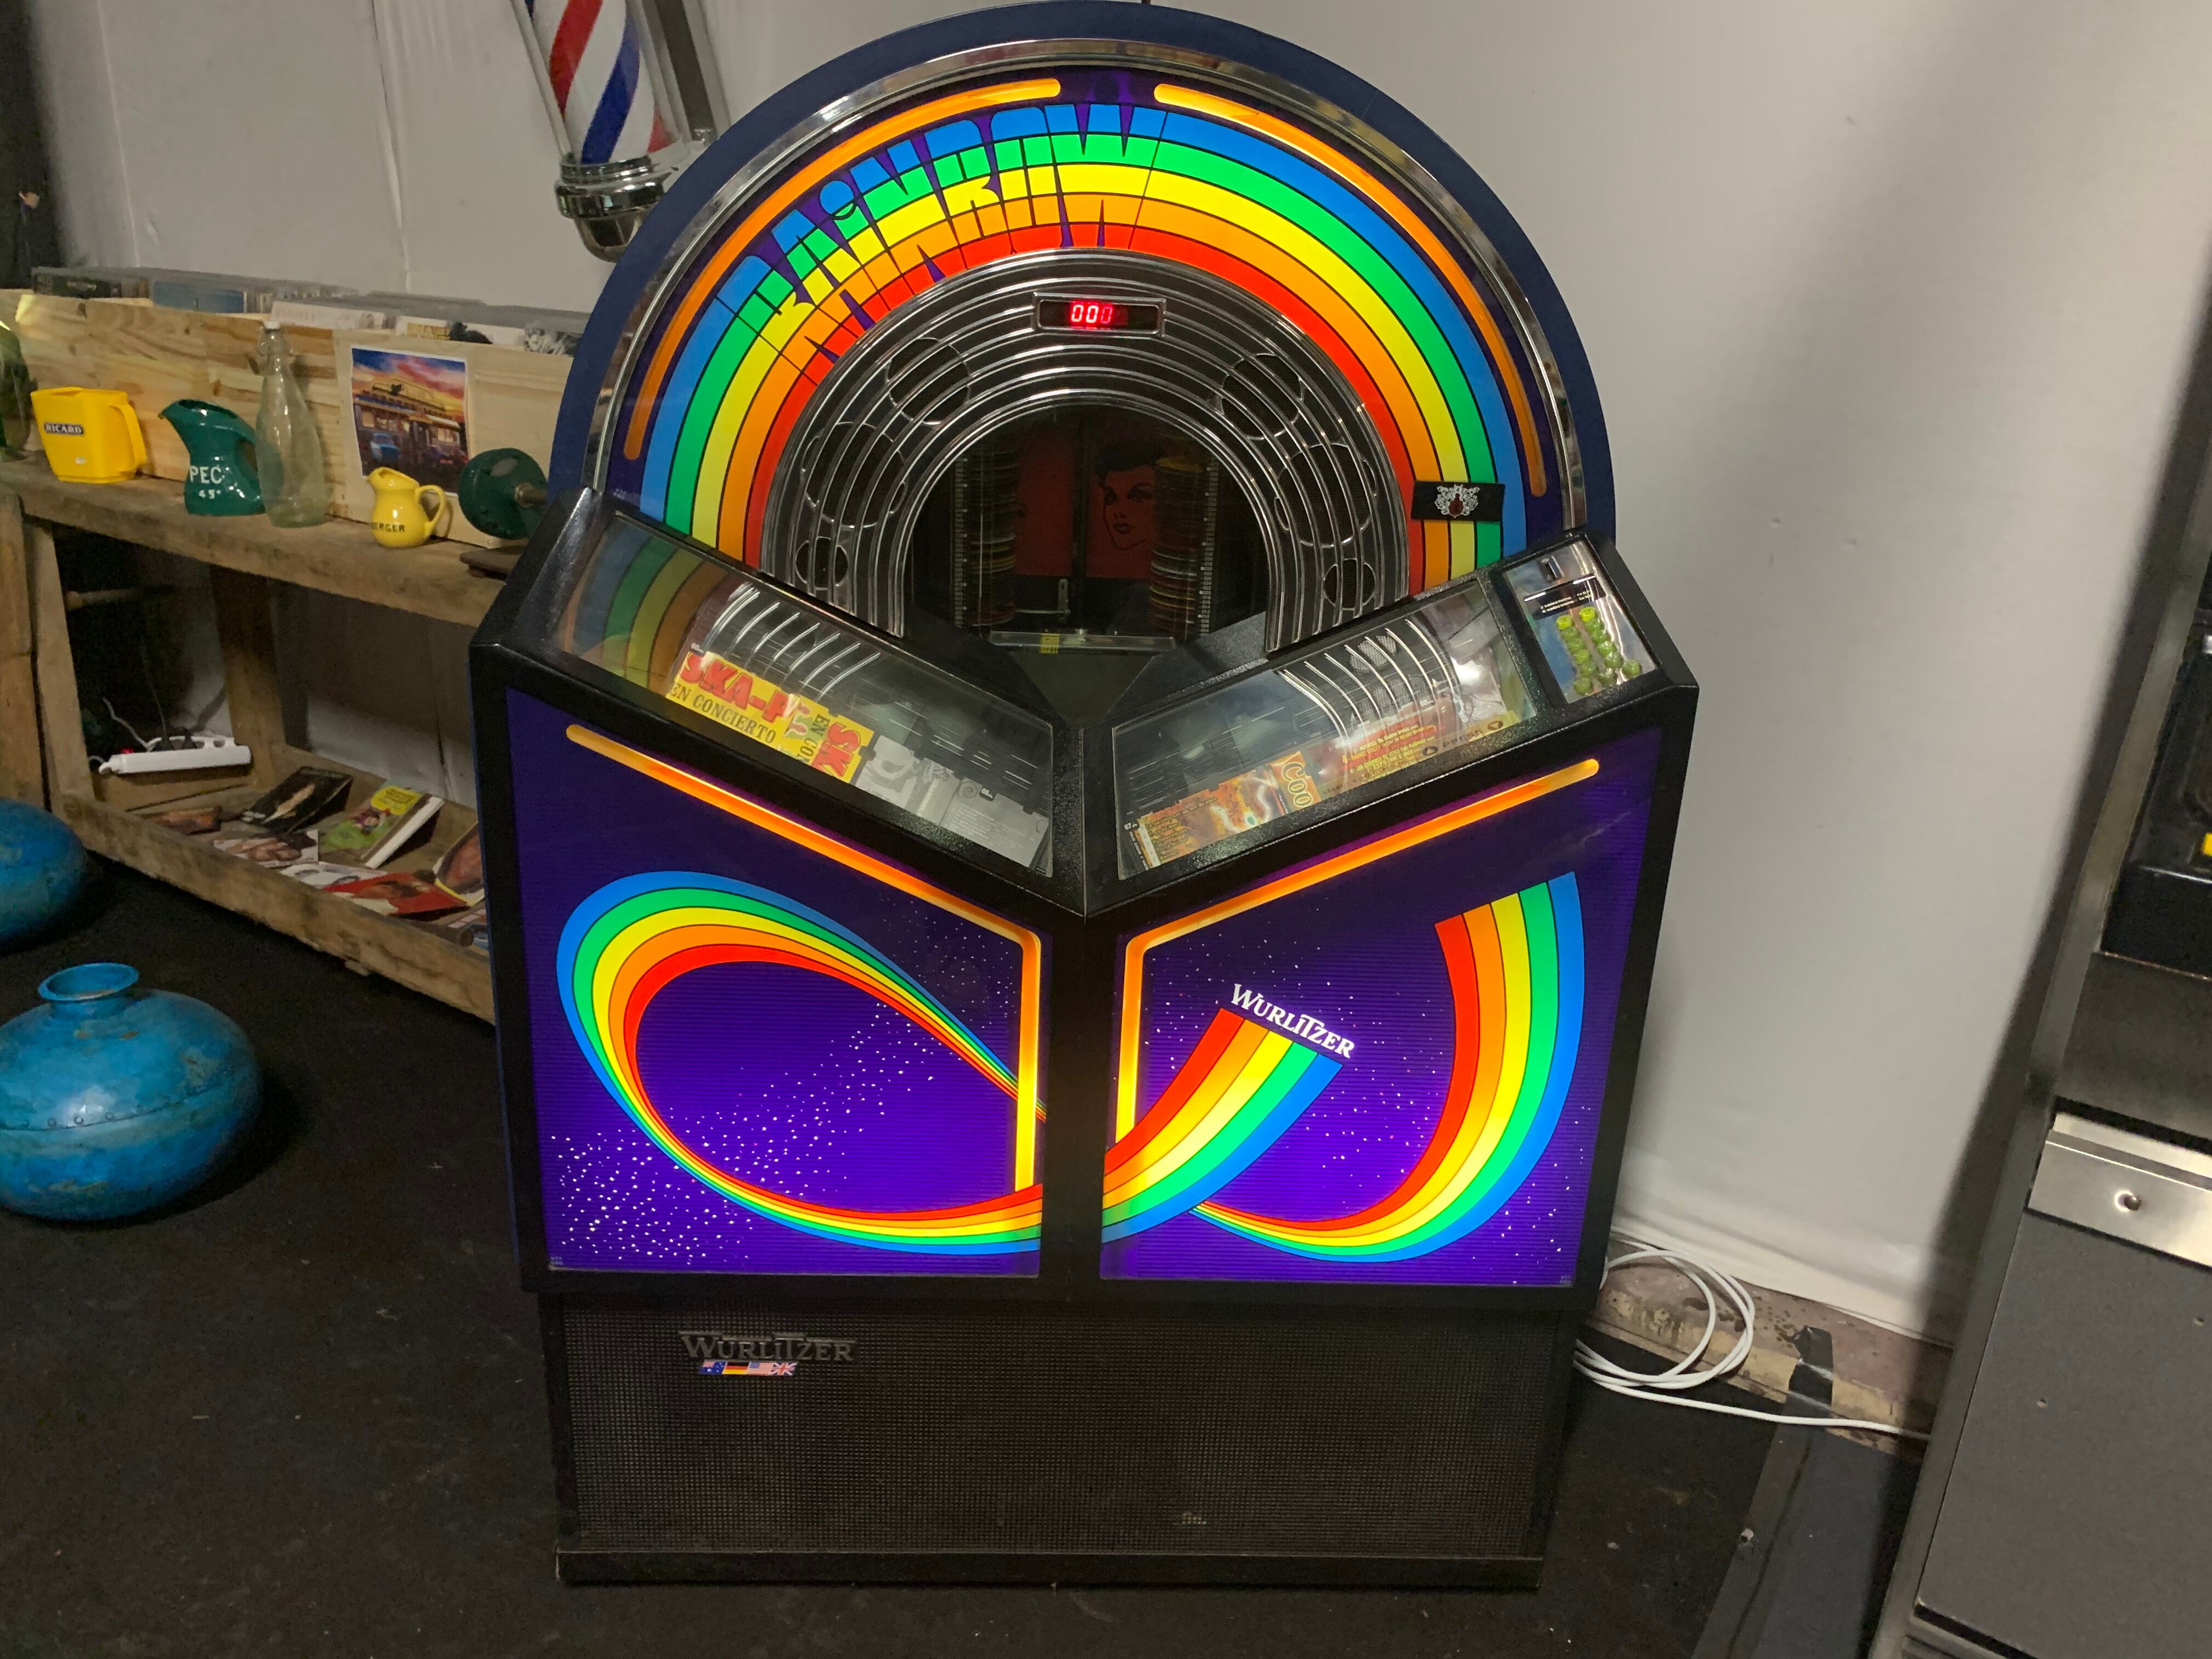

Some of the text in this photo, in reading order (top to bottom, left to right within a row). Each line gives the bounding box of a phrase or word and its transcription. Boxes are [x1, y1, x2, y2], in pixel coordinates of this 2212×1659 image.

[1071, 304, 1113, 324] 000
[45, 423, 82, 434] RICARD
[669, 682, 777, 744] EN CONCIERTO
[810, 714, 831, 737] EN
[812, 721, 861, 777] SK
[1443, 729, 1483, 748] PRESS
[1124, 822, 1132, 831] 67
[1231, 983, 1355, 1058] WURLITZER
[678, 1331, 856, 1361] WURLITZER
